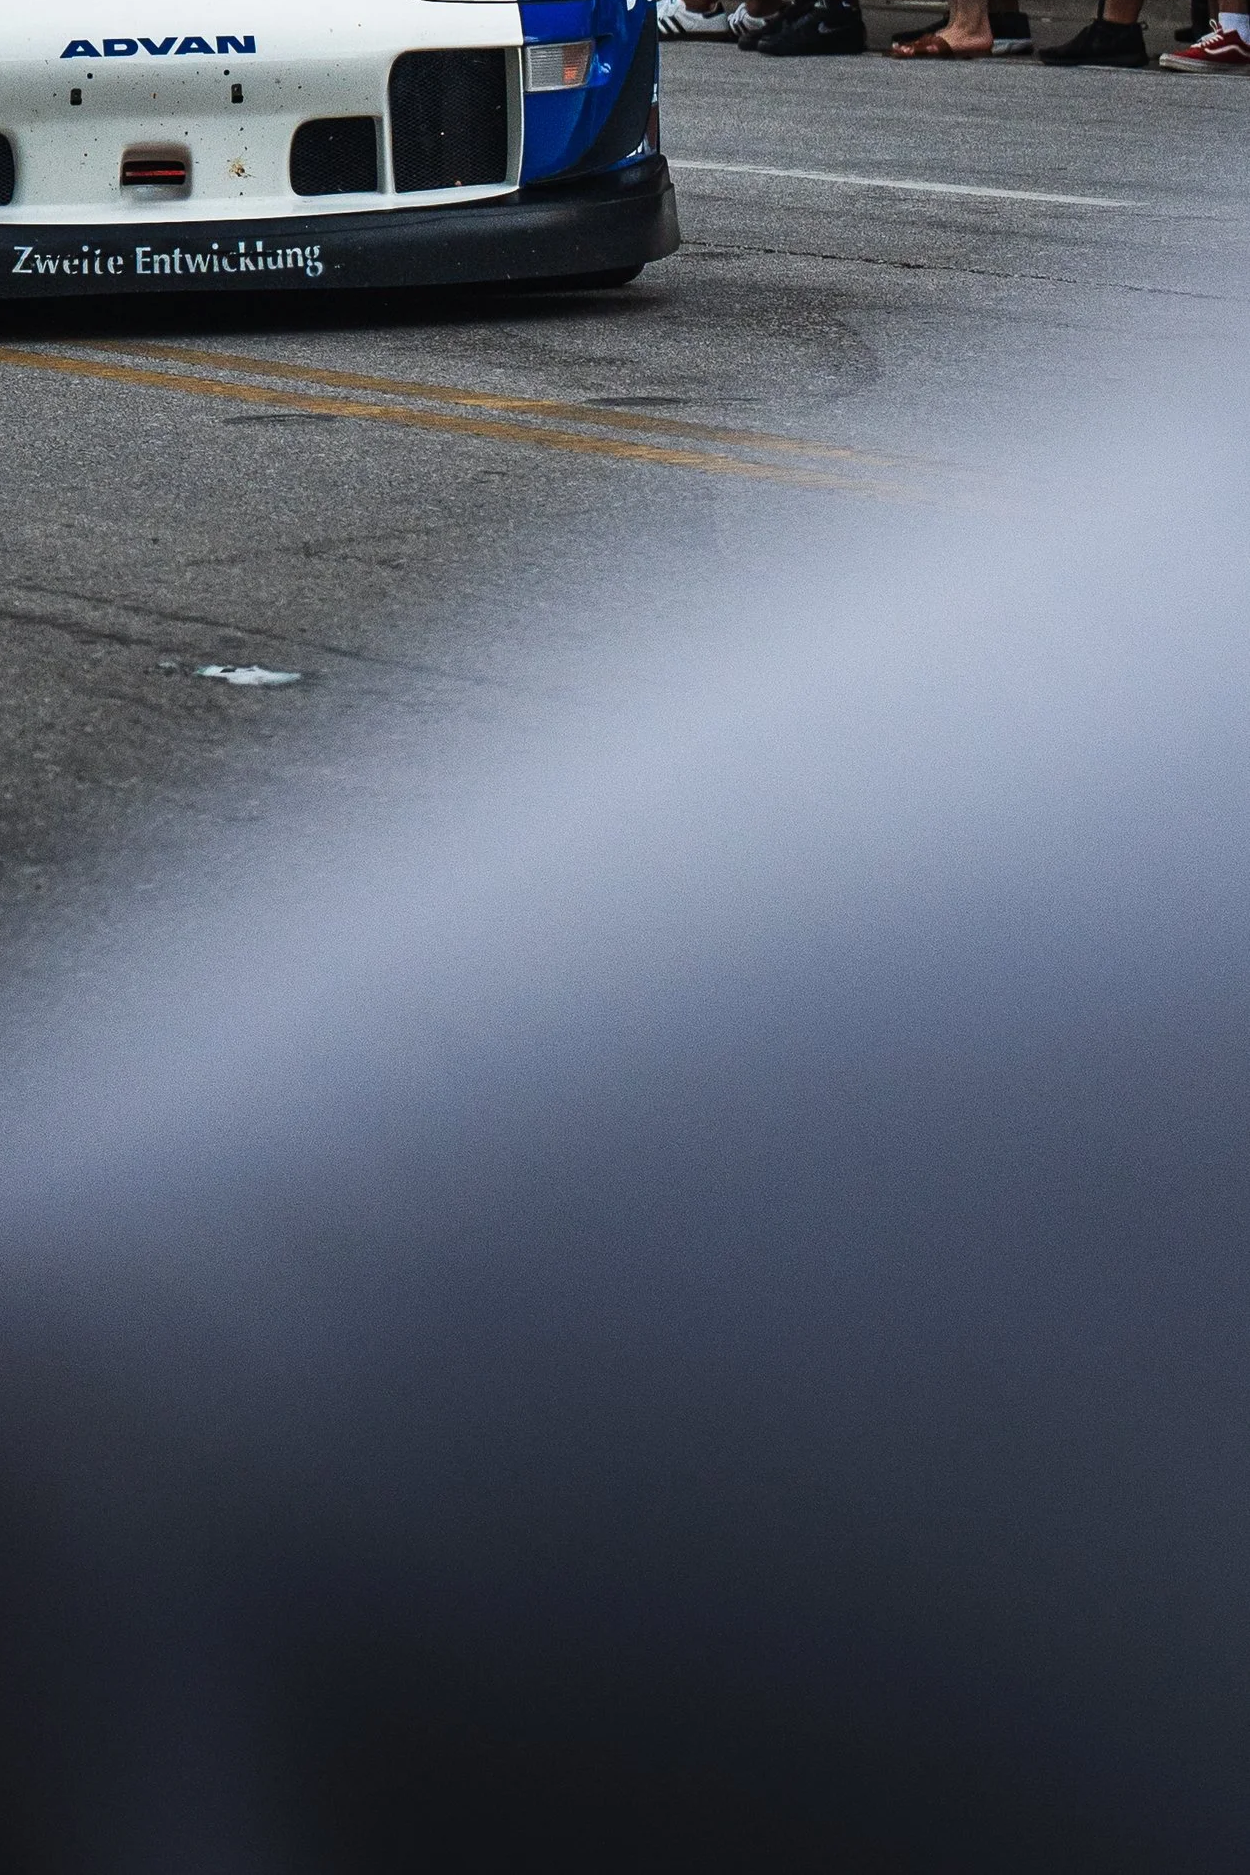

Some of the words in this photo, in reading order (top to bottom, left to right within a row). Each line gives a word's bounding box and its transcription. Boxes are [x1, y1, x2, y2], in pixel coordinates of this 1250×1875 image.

[59, 34, 257, 60] ADVAN
[11, 244, 124, 275] Zweite
[135, 240, 324, 278] Entwicklung
